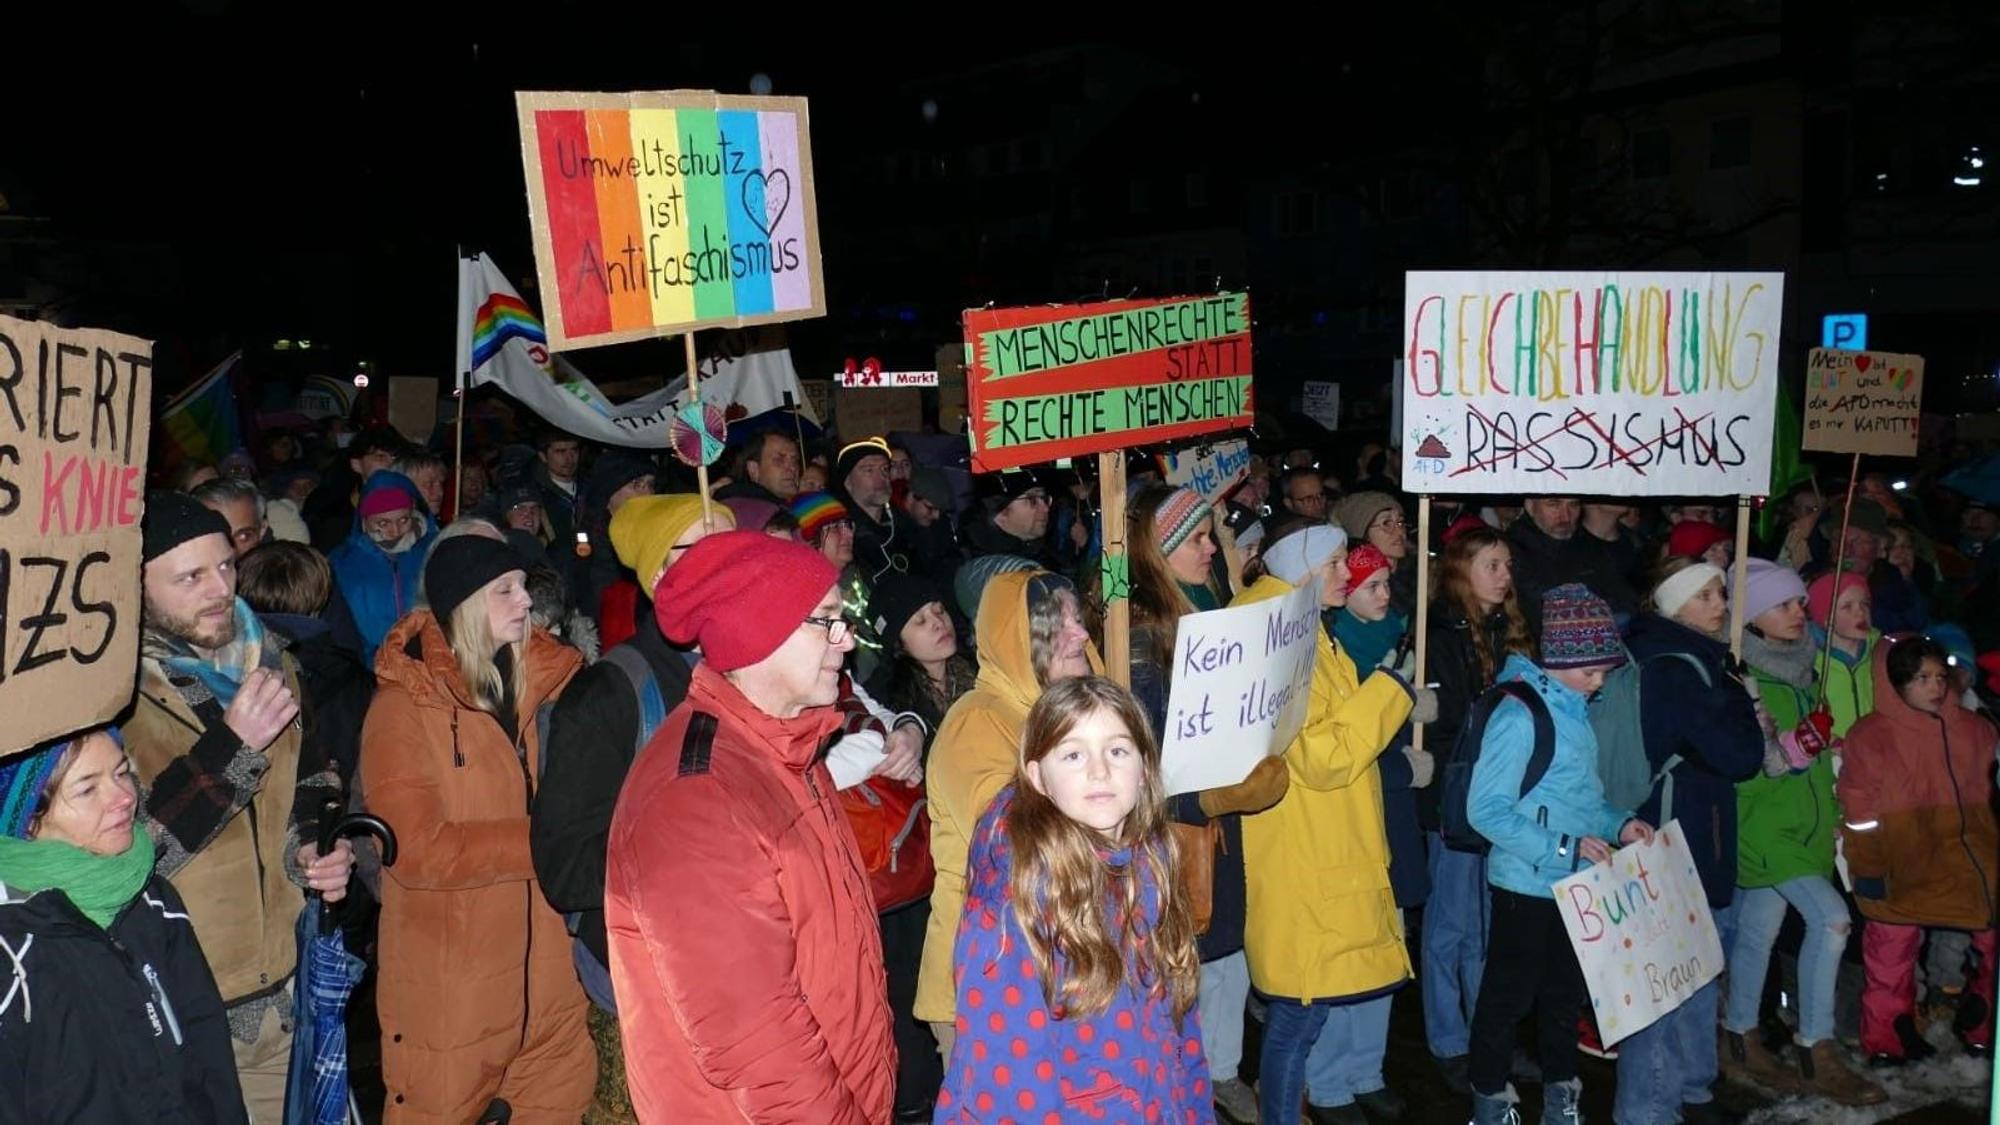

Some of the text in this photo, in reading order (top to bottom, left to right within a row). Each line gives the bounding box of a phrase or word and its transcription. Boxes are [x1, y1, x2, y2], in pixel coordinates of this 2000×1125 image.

[557, 130, 748, 180] Umweltschutz
[647, 184, 682, 228] ist
[575, 224, 799, 299] Antifaschismus
[995, 297, 1238, 377] MENSCHENRECHTE
[1167, 339, 1243, 382] STATT
[1408, 283, 1764, 402] GLEICHBEHANDLUNG
[1811, 350, 1852, 369] Mein
[896, 374, 935, 385] Markt
[1808, 394, 1828, 410] die
[1856, 376, 1881, 389] und
[1001, 391, 1105, 447] RECHTE
[1124, 378, 1241, 428] MENSCHEN
[1465, 411, 1751, 473] RASSISMUS
[39, 450, 141, 538] KNIE
[1184, 586, 1319, 679] Kein Mensch
[1177, 693, 1214, 741] ist
[1568, 852, 1660, 943] Bunt
[1644, 956, 1703, 1003] Braun
